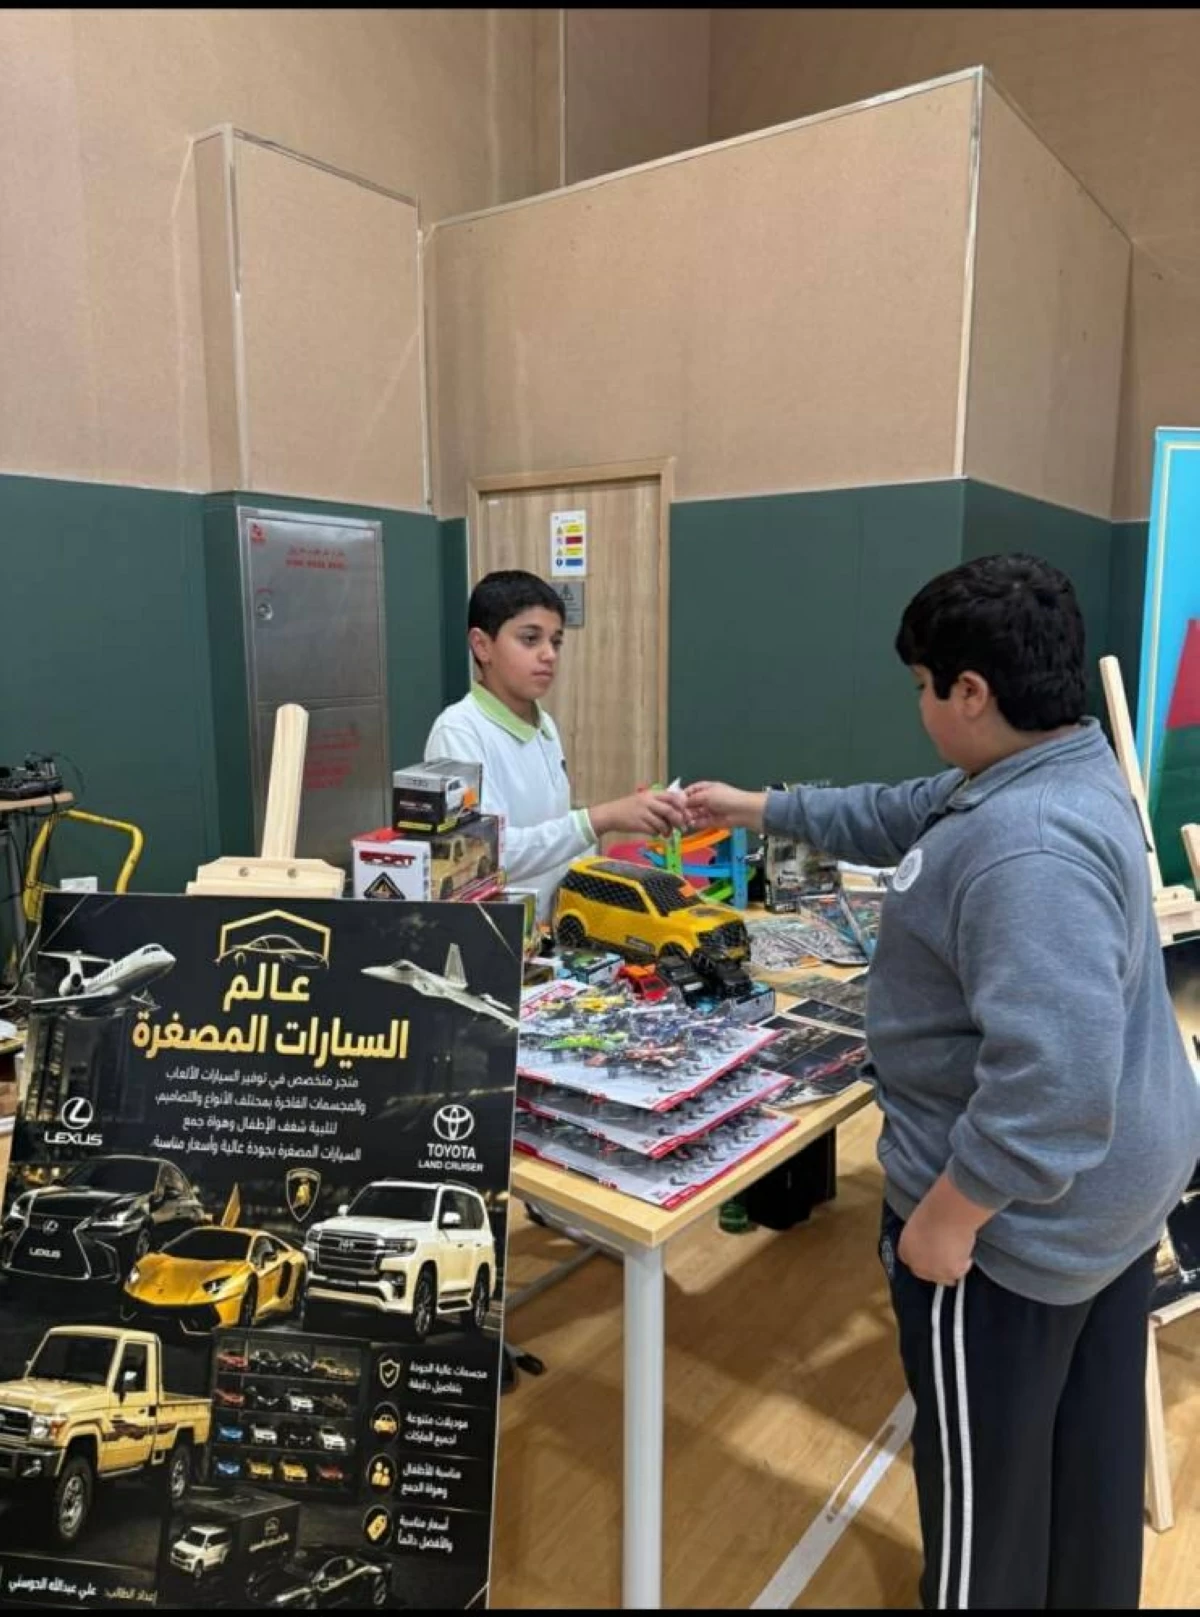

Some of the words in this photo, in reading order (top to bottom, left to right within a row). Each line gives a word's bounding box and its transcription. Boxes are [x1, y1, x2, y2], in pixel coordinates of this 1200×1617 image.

[223, 962, 310, 1012] عالم
[132, 1010, 269, 1059] المصغرة
[274, 1016, 411, 1069] السيارات
[165, 1065, 200, 1082] الألعاب
[201, 1068, 241, 1085] السيارات
[241, 1071, 269, 1087] توفير
[268, 1072, 286, 1090] في
[286, 1074, 333, 1089] متخصص
[333, 1076, 360, 1091] متجر
[203, 1090, 234, 1109] الأنواع
[234, 1093, 272, 1110] بمختلف
[274, 1094, 308, 1112] الفاخرة
[308, 1097, 367, 1116] والمجسمات
[182, 1115, 205, 1132] جمع
[206, 1114, 236, 1133] وهواة
[276, 1118, 307, 1133] شغف
[308, 1119, 338, 1137] لتلبية
[44, 1131, 103, 1146] LEXUS
[186, 1133, 219, 1155] وأسعار
[220, 1138, 245, 1156] عالية
[246, 1141, 276, 1159] بجودة
[278, 1142, 319, 1160] المصغرة
[320, 1144, 362, 1163] السيارات
[427, 1143, 477, 1160] TOYOTA
[418, 1159, 443, 1169] LAND
[445, 1161, 484, 1172] CRUISER
